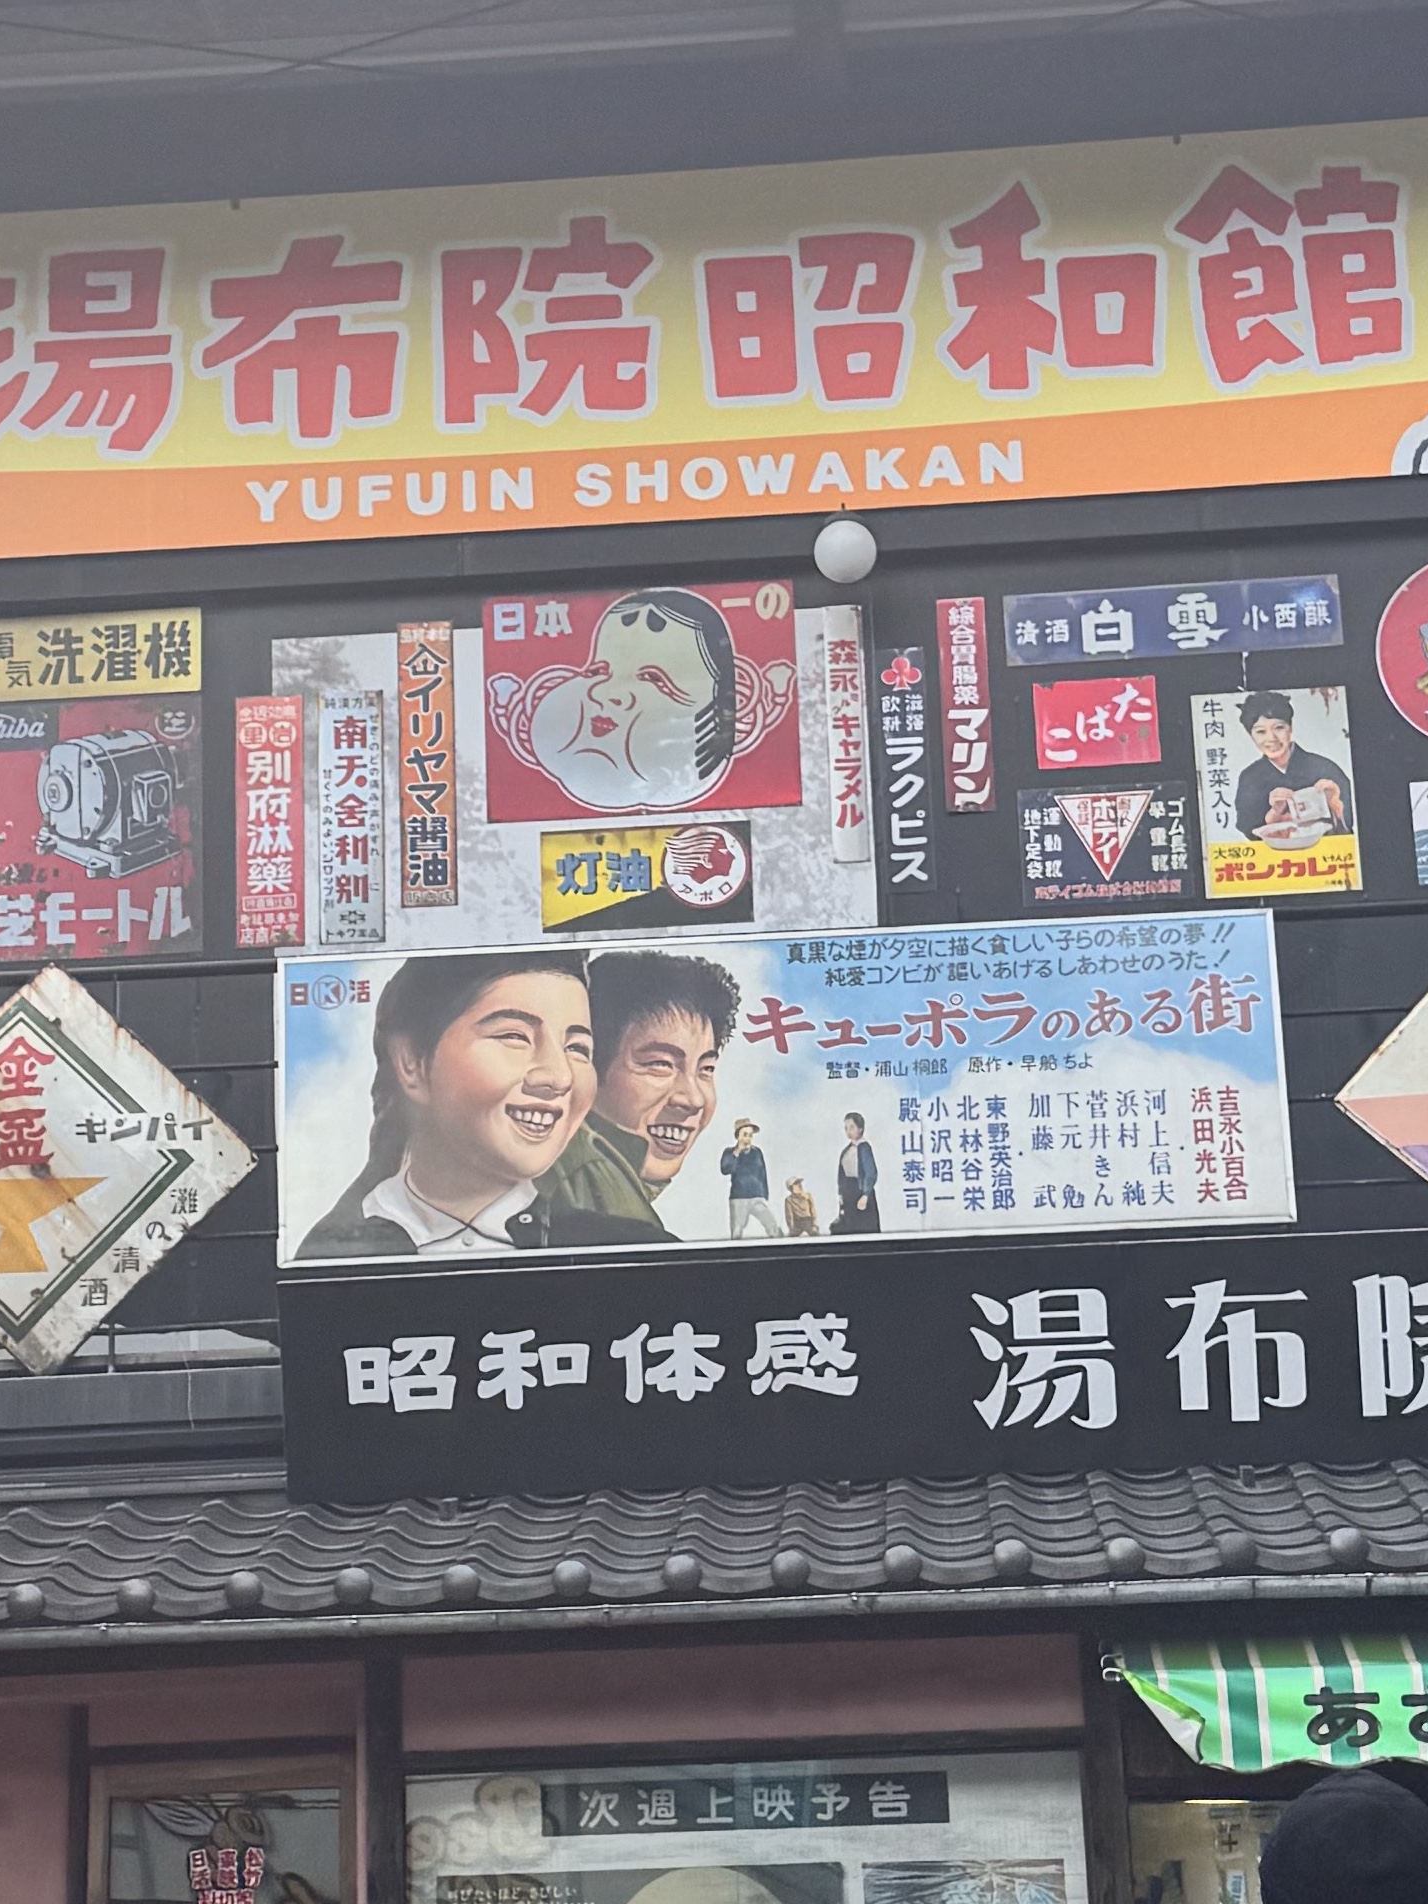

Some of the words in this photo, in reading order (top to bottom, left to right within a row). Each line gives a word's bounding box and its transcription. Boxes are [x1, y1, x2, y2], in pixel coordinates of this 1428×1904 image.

[246, 466, 535, 521] YUFUIN
[572, 440, 1025, 508] SHOWAKAN
[1045, 682, 1153, 764] たばこ
[885, 736, 928, 883] ラクピス
[1206, 747, 1232, 829] 野菜入り
[556, 848, 653, 895] 灯油
[1213, 847, 1256, 860] 大塚の
[1215, 857, 1355, 883] ボンカレー
[742, 972, 1261, 1054] キューポラのある街
[76, 1113, 213, 1143] キンパイ
[899, 1099, 928, 1214] 殿山泰司
[927, 1098, 956, 1202] 小沢昭一
[956, 1096, 985, 1211] 北林谷栄
[984, 1094, 1017, 1210] 東野英治郎
[1143, 1088, 1175, 1205] 河上信夫
[1190, 1086, 1221, 1205] 浜田光夫
[1218, 1084, 1250, 1202] 吉永小百合
[343, 1312, 860, 1413] 昭和体感
[579, 1781, 911, 1827] 次週上映予告
